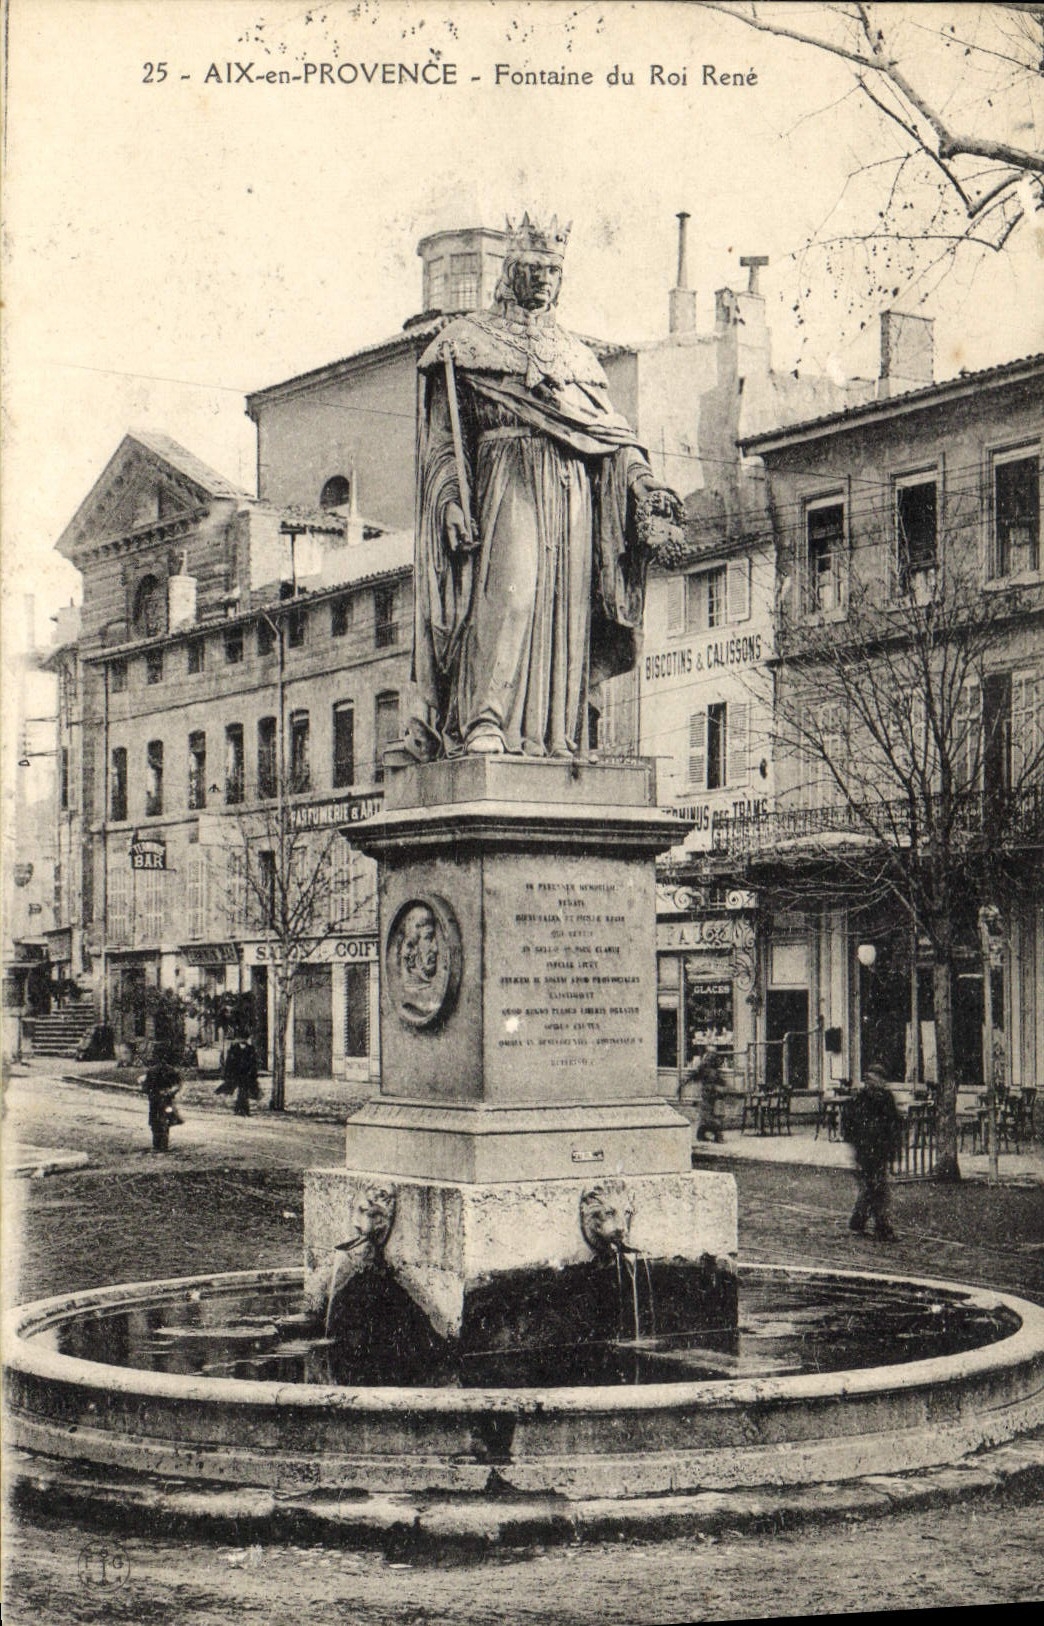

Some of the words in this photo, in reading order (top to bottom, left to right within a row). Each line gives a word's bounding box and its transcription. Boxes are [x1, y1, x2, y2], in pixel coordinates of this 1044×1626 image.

[645, 648, 692, 680] BISCOTINS
[696, 652, 704, 671] &
[706, 634, 761, 669] CALISSONS
[134, 854, 163, 868] BAR
[693, 985, 731, 994] GLACES
